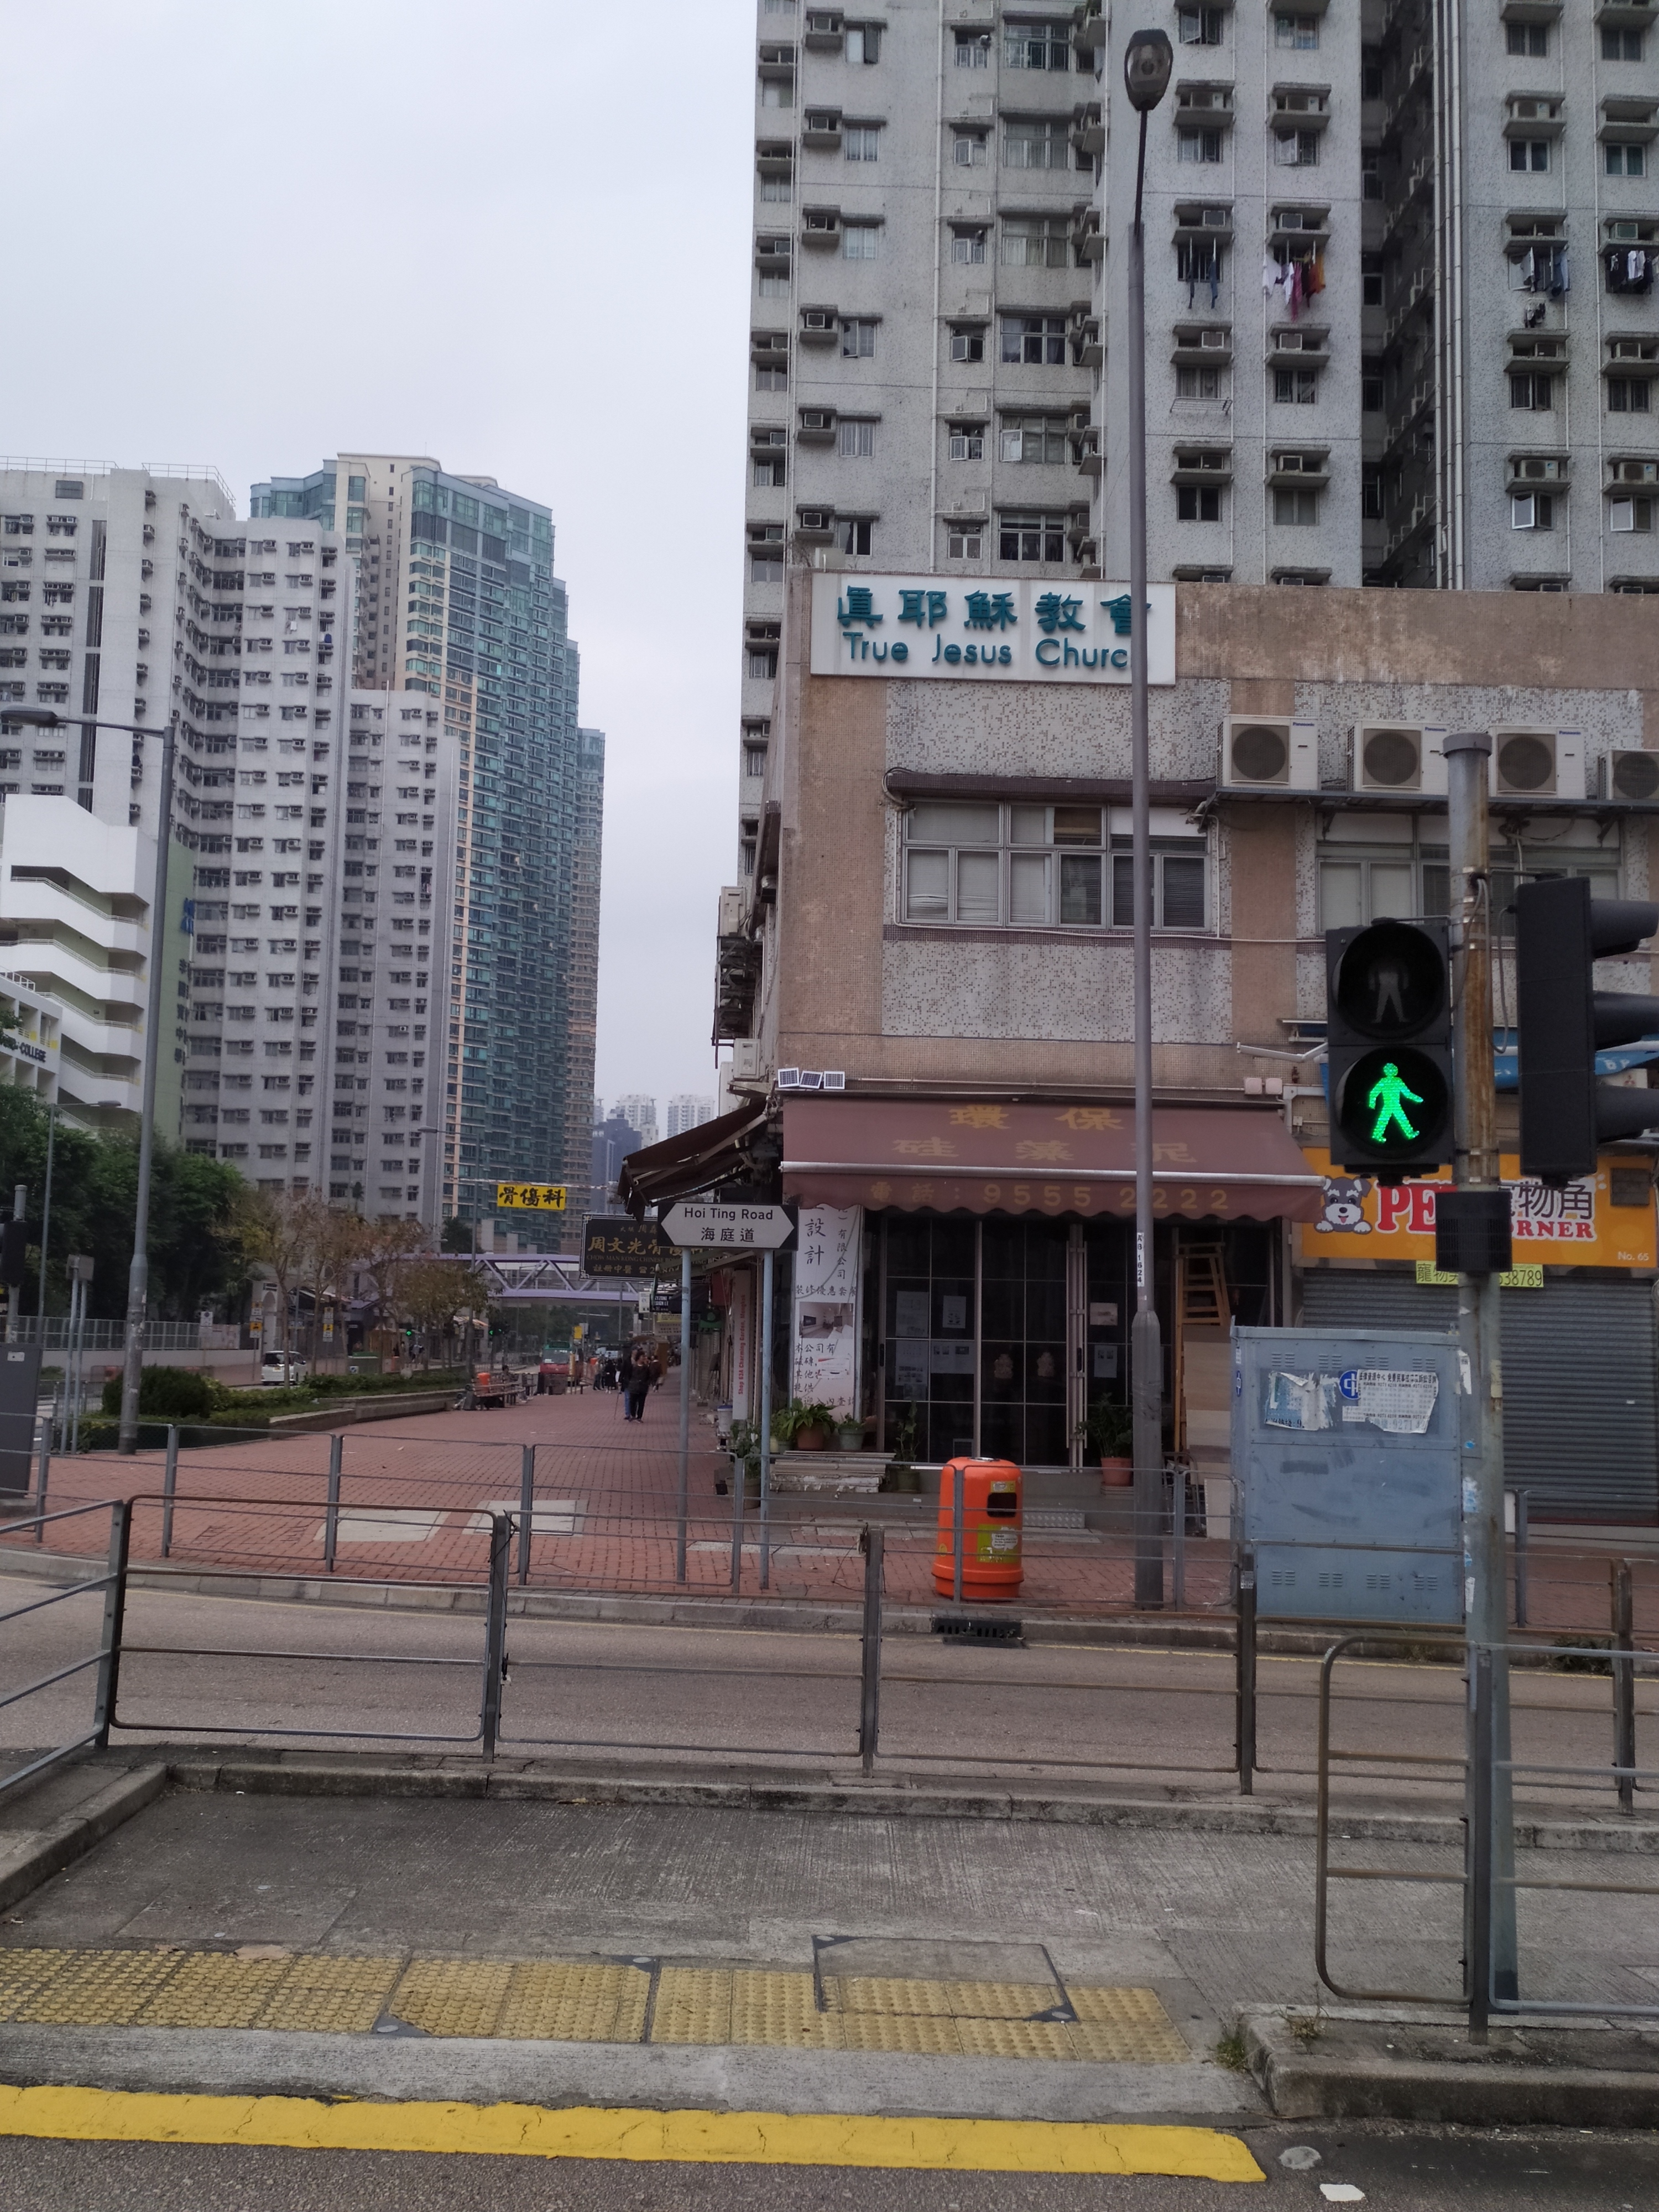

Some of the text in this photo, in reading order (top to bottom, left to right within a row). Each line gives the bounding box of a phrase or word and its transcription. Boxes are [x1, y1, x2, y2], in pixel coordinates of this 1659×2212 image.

[842, 631, 1130, 667] True Jesus Churc
[949, 1105, 1125, 1130] 環保
[499, 1186, 564, 1208] 骨傷科
[983, 1183, 1092, 1207] 9555
[1120, 1187, 1229, 1211] 2222
[1377, 1183, 1458, 1232] PE
[1510, 1181, 1593, 1219] 物角
[685, 1207, 773, 1221] Hoi Ting Road
[701, 1227, 754, 1242] 海庭道
[804, 1207, 826, 1266] 設計
[1510, 1219, 1594, 1239] RNER
[1617, 1251, 1649, 1261] No. 65
[1417, 1263, 1458, 1283] 寵物
